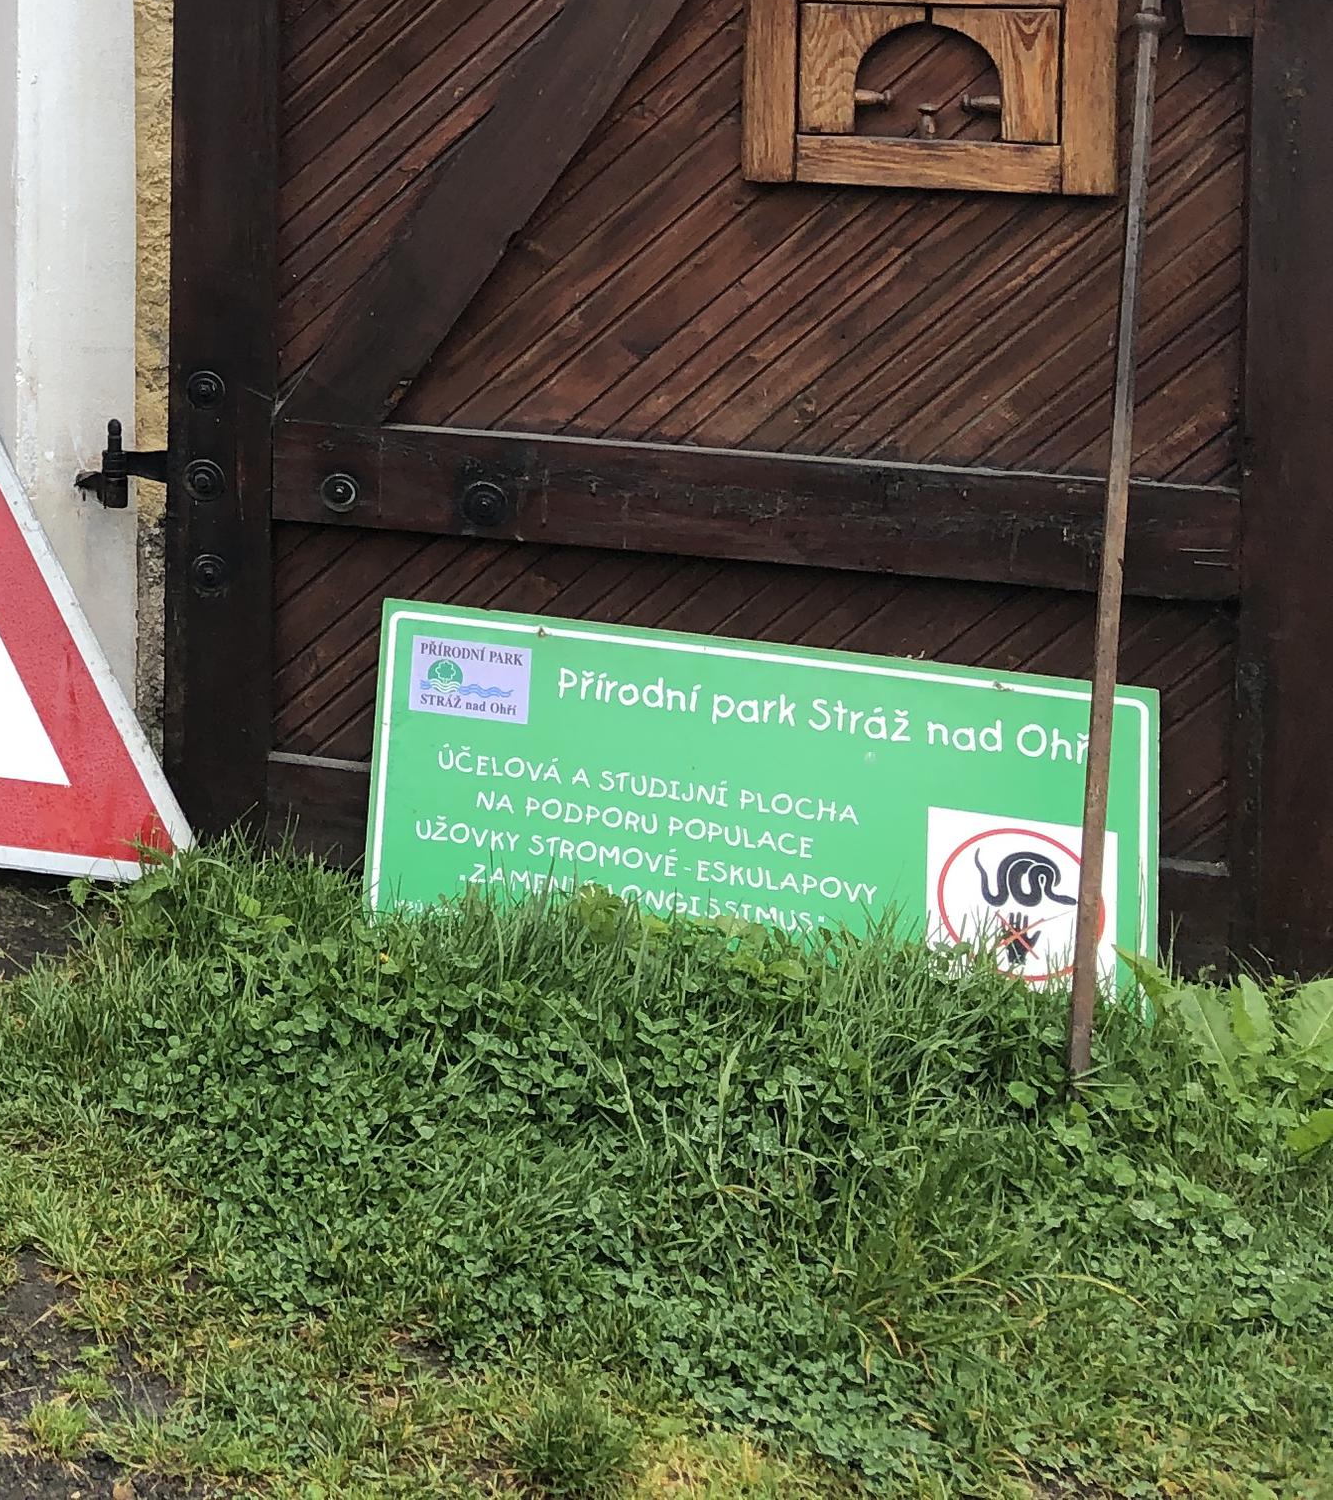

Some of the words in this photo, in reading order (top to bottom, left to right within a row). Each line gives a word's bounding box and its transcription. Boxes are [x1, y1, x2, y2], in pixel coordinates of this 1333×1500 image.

[421, 641, 486, 661] PŘÍRODNÍ
[489, 651, 523, 666] PARK
[420, 693, 462, 709] STRÁŽ
[465, 701, 486, 712] nad
[490, 702, 517, 716] Ohří
[558, 667, 702, 714] Přírodní
[712, 693, 796, 727] park
[808, 698, 911, 743] Stráž
[927, 719, 1002, 752] nad
[1017, 723, 1090, 765] Ohř
[437, 744, 561, 784] ÚČELOVÁ
[571, 768, 590, 788] A
[598, 770, 729, 808] STUDIJNÍ
[739, 789, 860, 826] PLOCHA
[414, 815, 520, 853] UŽOVKY
[528, 834, 678, 878] STROMOVÉ
[697, 860, 878, 905] ESKULAPOVY
[476, 791, 514, 814] NA
[525, 796, 658, 835] PODPORU
[668, 815, 813, 860] POPULACE
